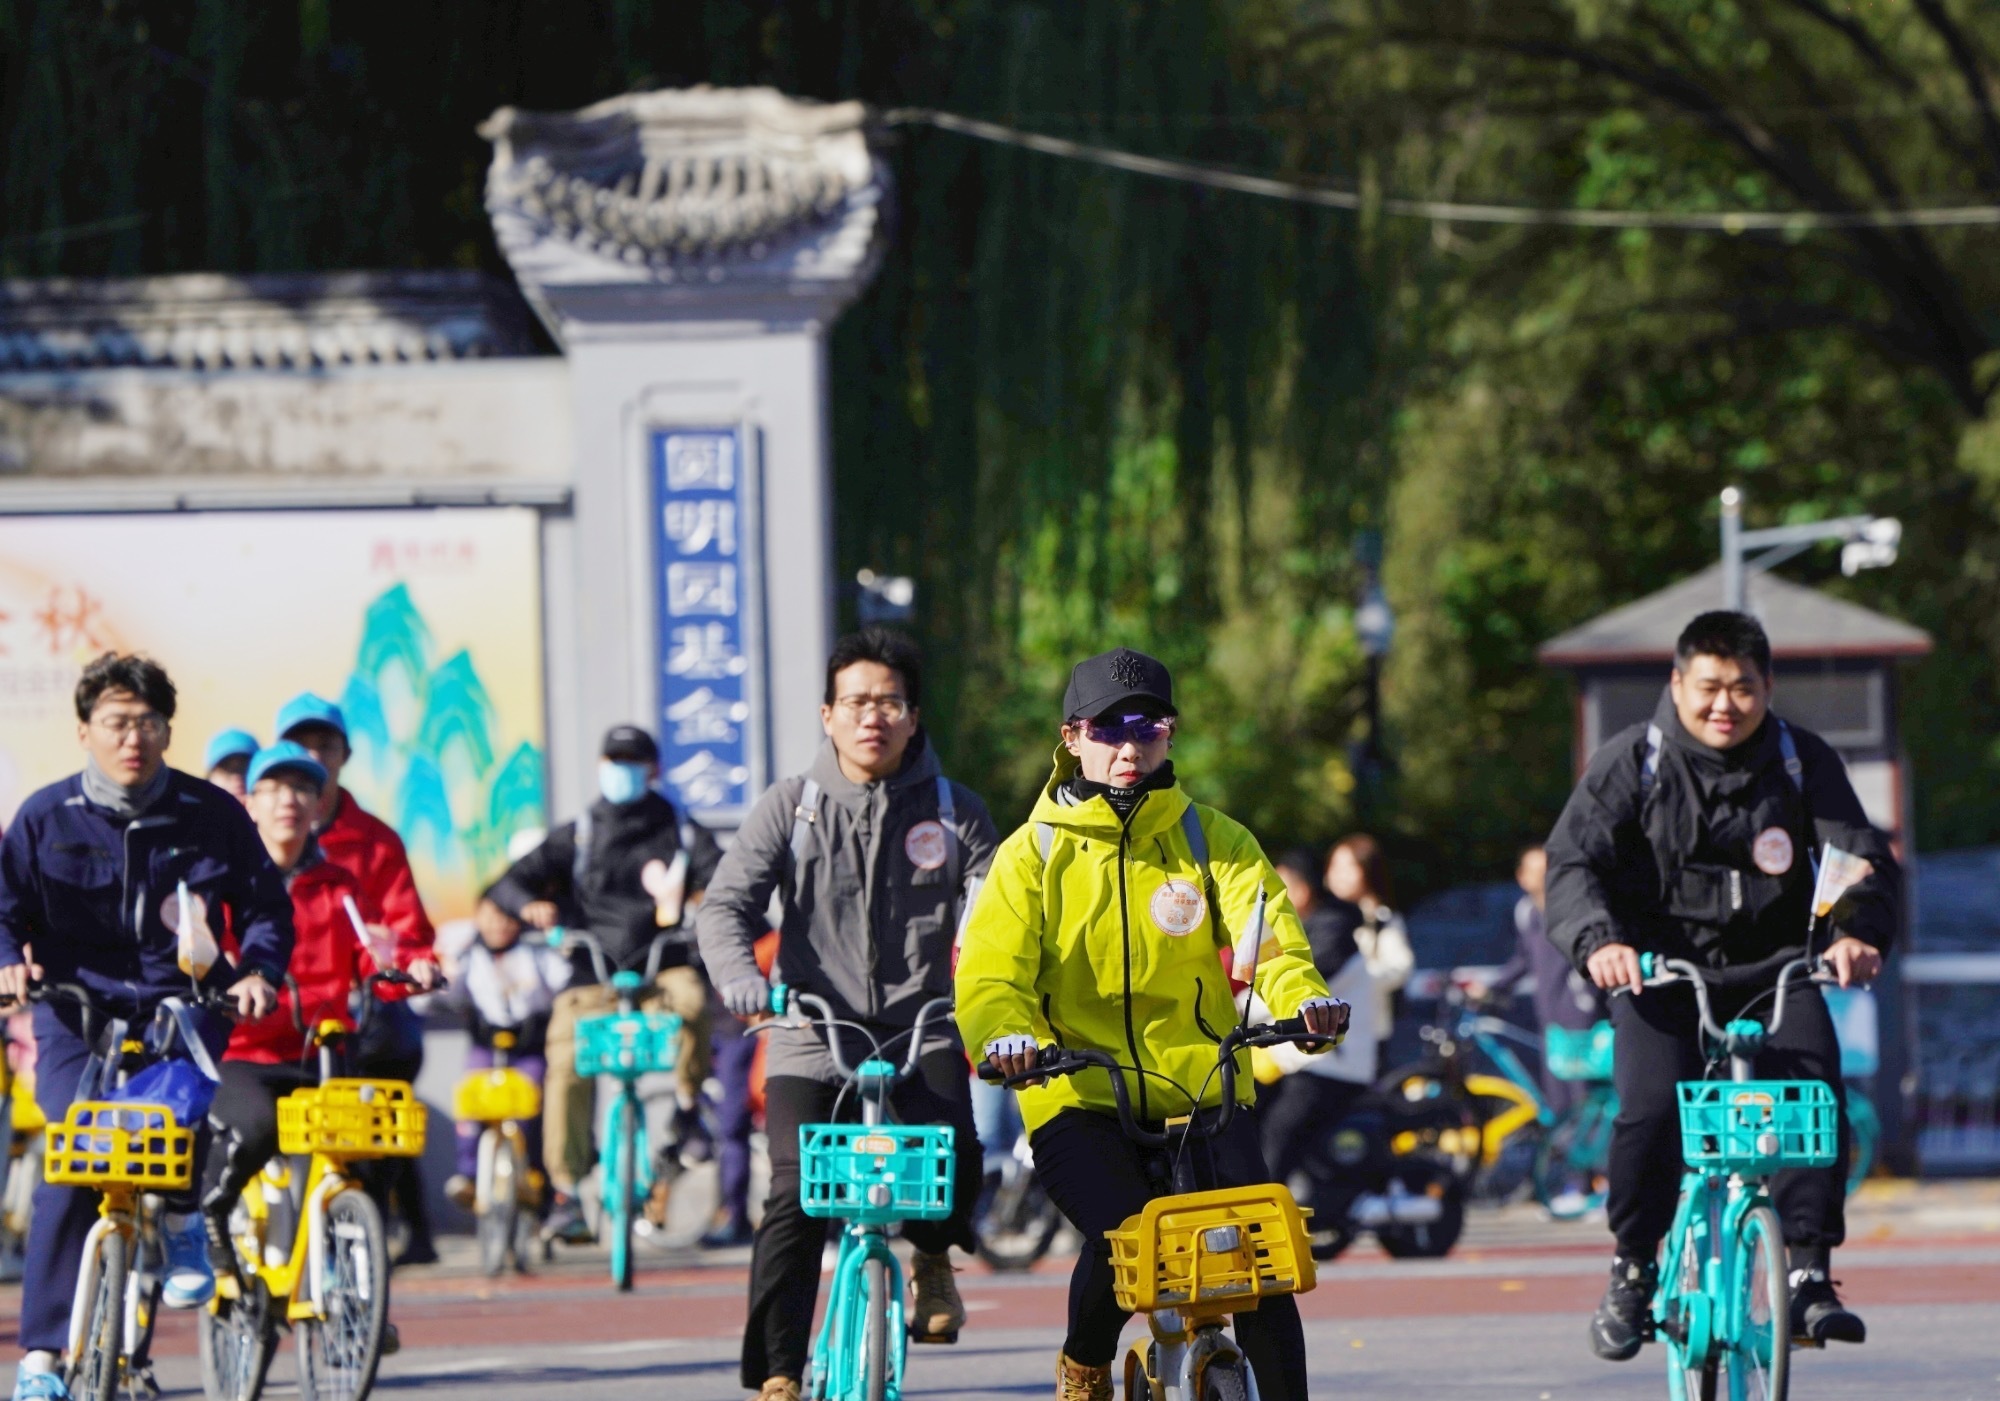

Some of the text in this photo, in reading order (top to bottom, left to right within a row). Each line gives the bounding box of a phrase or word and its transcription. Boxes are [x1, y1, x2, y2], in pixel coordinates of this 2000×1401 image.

[664, 434, 749, 806] 圆明园基金会
